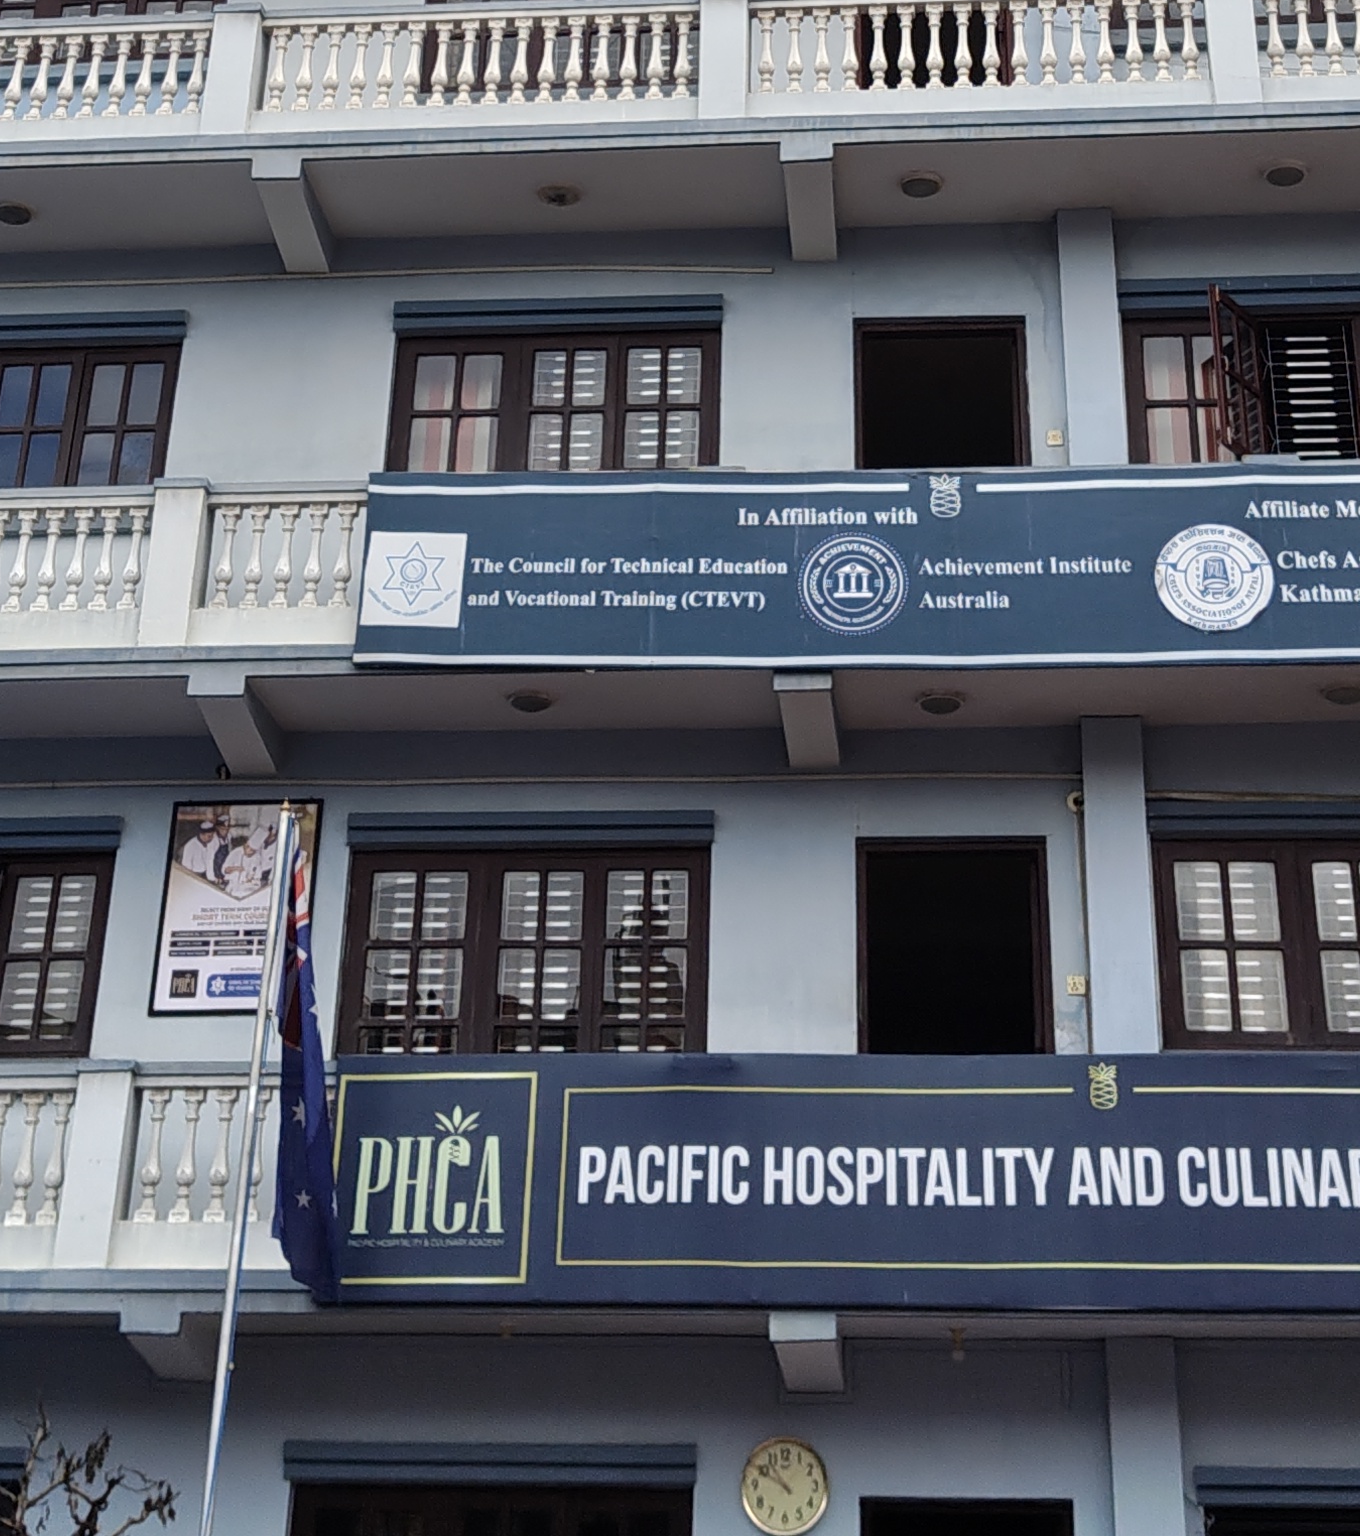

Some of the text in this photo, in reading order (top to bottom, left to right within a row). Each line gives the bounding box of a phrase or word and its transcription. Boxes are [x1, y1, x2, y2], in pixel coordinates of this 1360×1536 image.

[738, 507, 918, 526] In Affiliation with
[1244, 500, 1330, 519] Affiliate
[819, 542, 887, 565] ACHIEVEMENT
[1277, 550, 1338, 570] Chefs
[471, 557, 788, 575] The Council for Technical Education
[918, 556, 1133, 576] Achievement Institute
[467, 590, 500, 607] and
[505, 590, 597, 607] Vocational
[600, 590, 677, 611] Training
[681, 590, 766, 611] (CTEVT)
[919, 590, 1010, 609] Australia
[349, 1135, 505, 1235] PHCA
[577, 1144, 750, 1206] PACIFIC
[764, 1145, 1054, 1207] HOSPITALITY
[1069, 1147, 1163, 1207] AND
